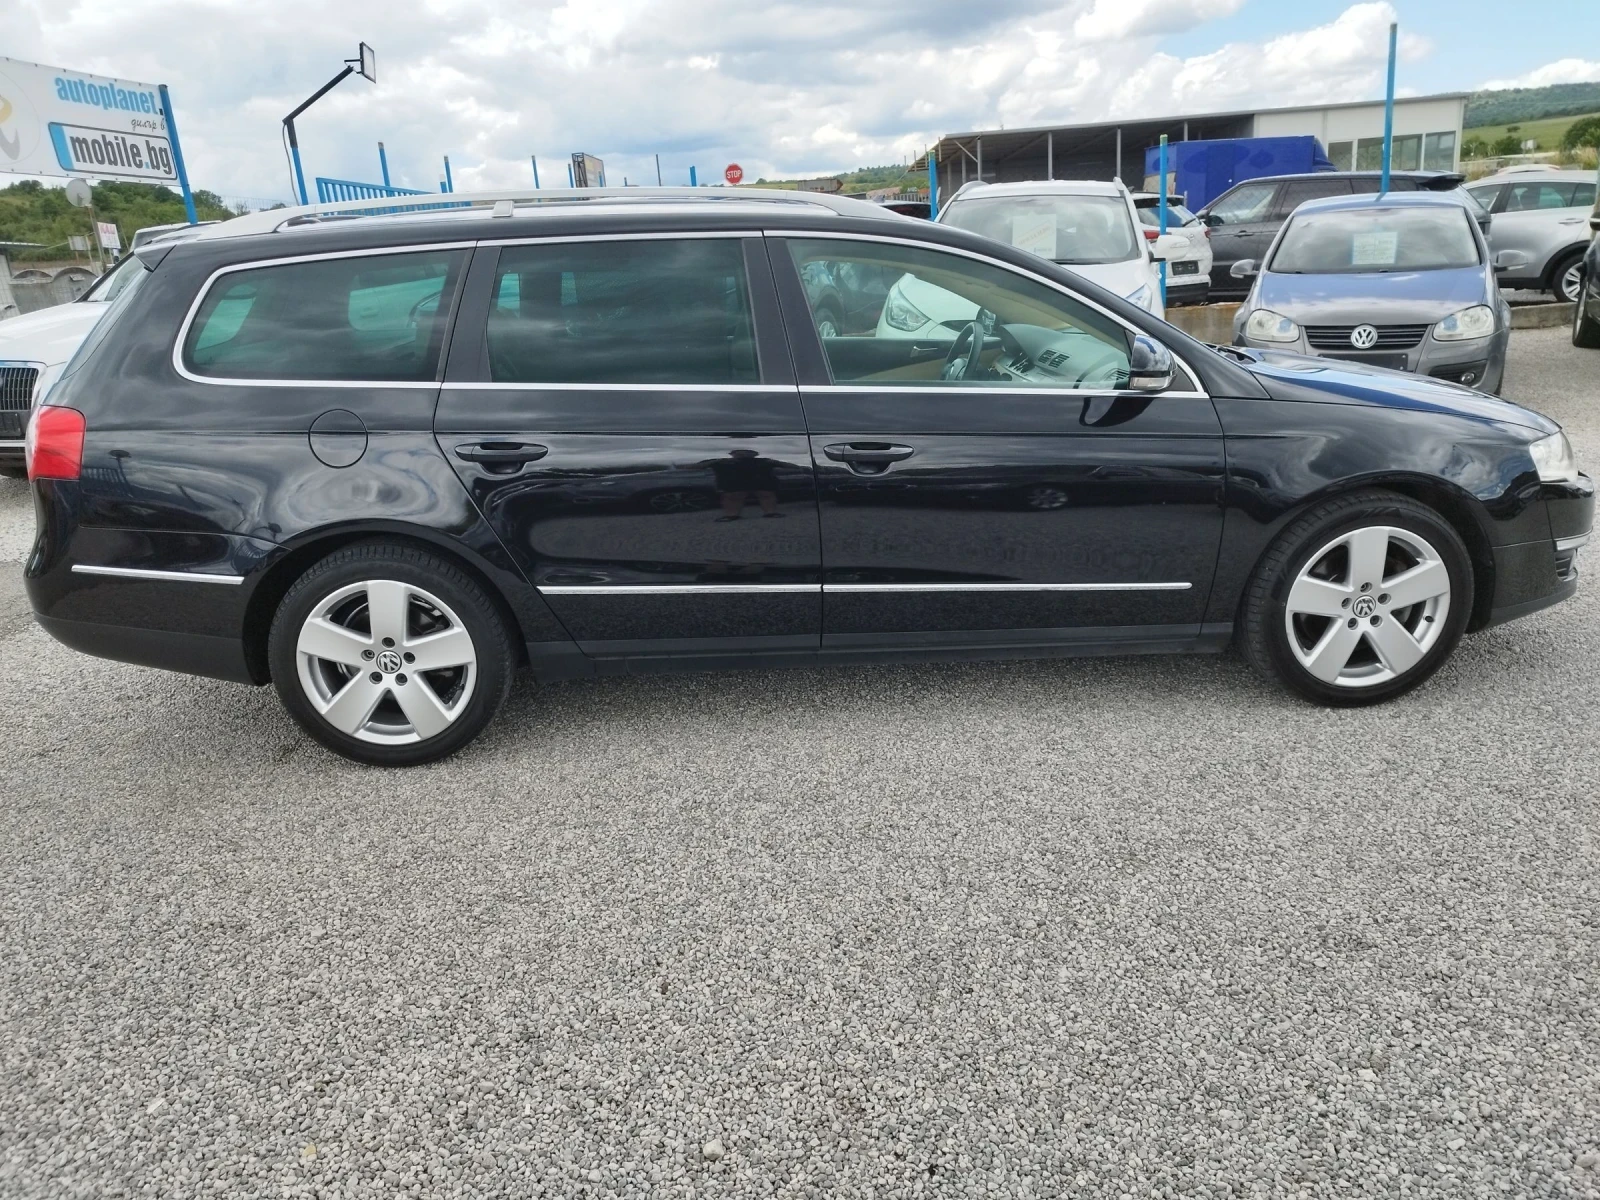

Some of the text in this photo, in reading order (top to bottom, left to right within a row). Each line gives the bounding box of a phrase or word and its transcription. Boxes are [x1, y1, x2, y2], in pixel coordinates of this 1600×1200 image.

[70, 134, 173, 175] mobile.bg
[726, 169, 742, 178] STOP
[1353, 327, 1376, 348] VW
